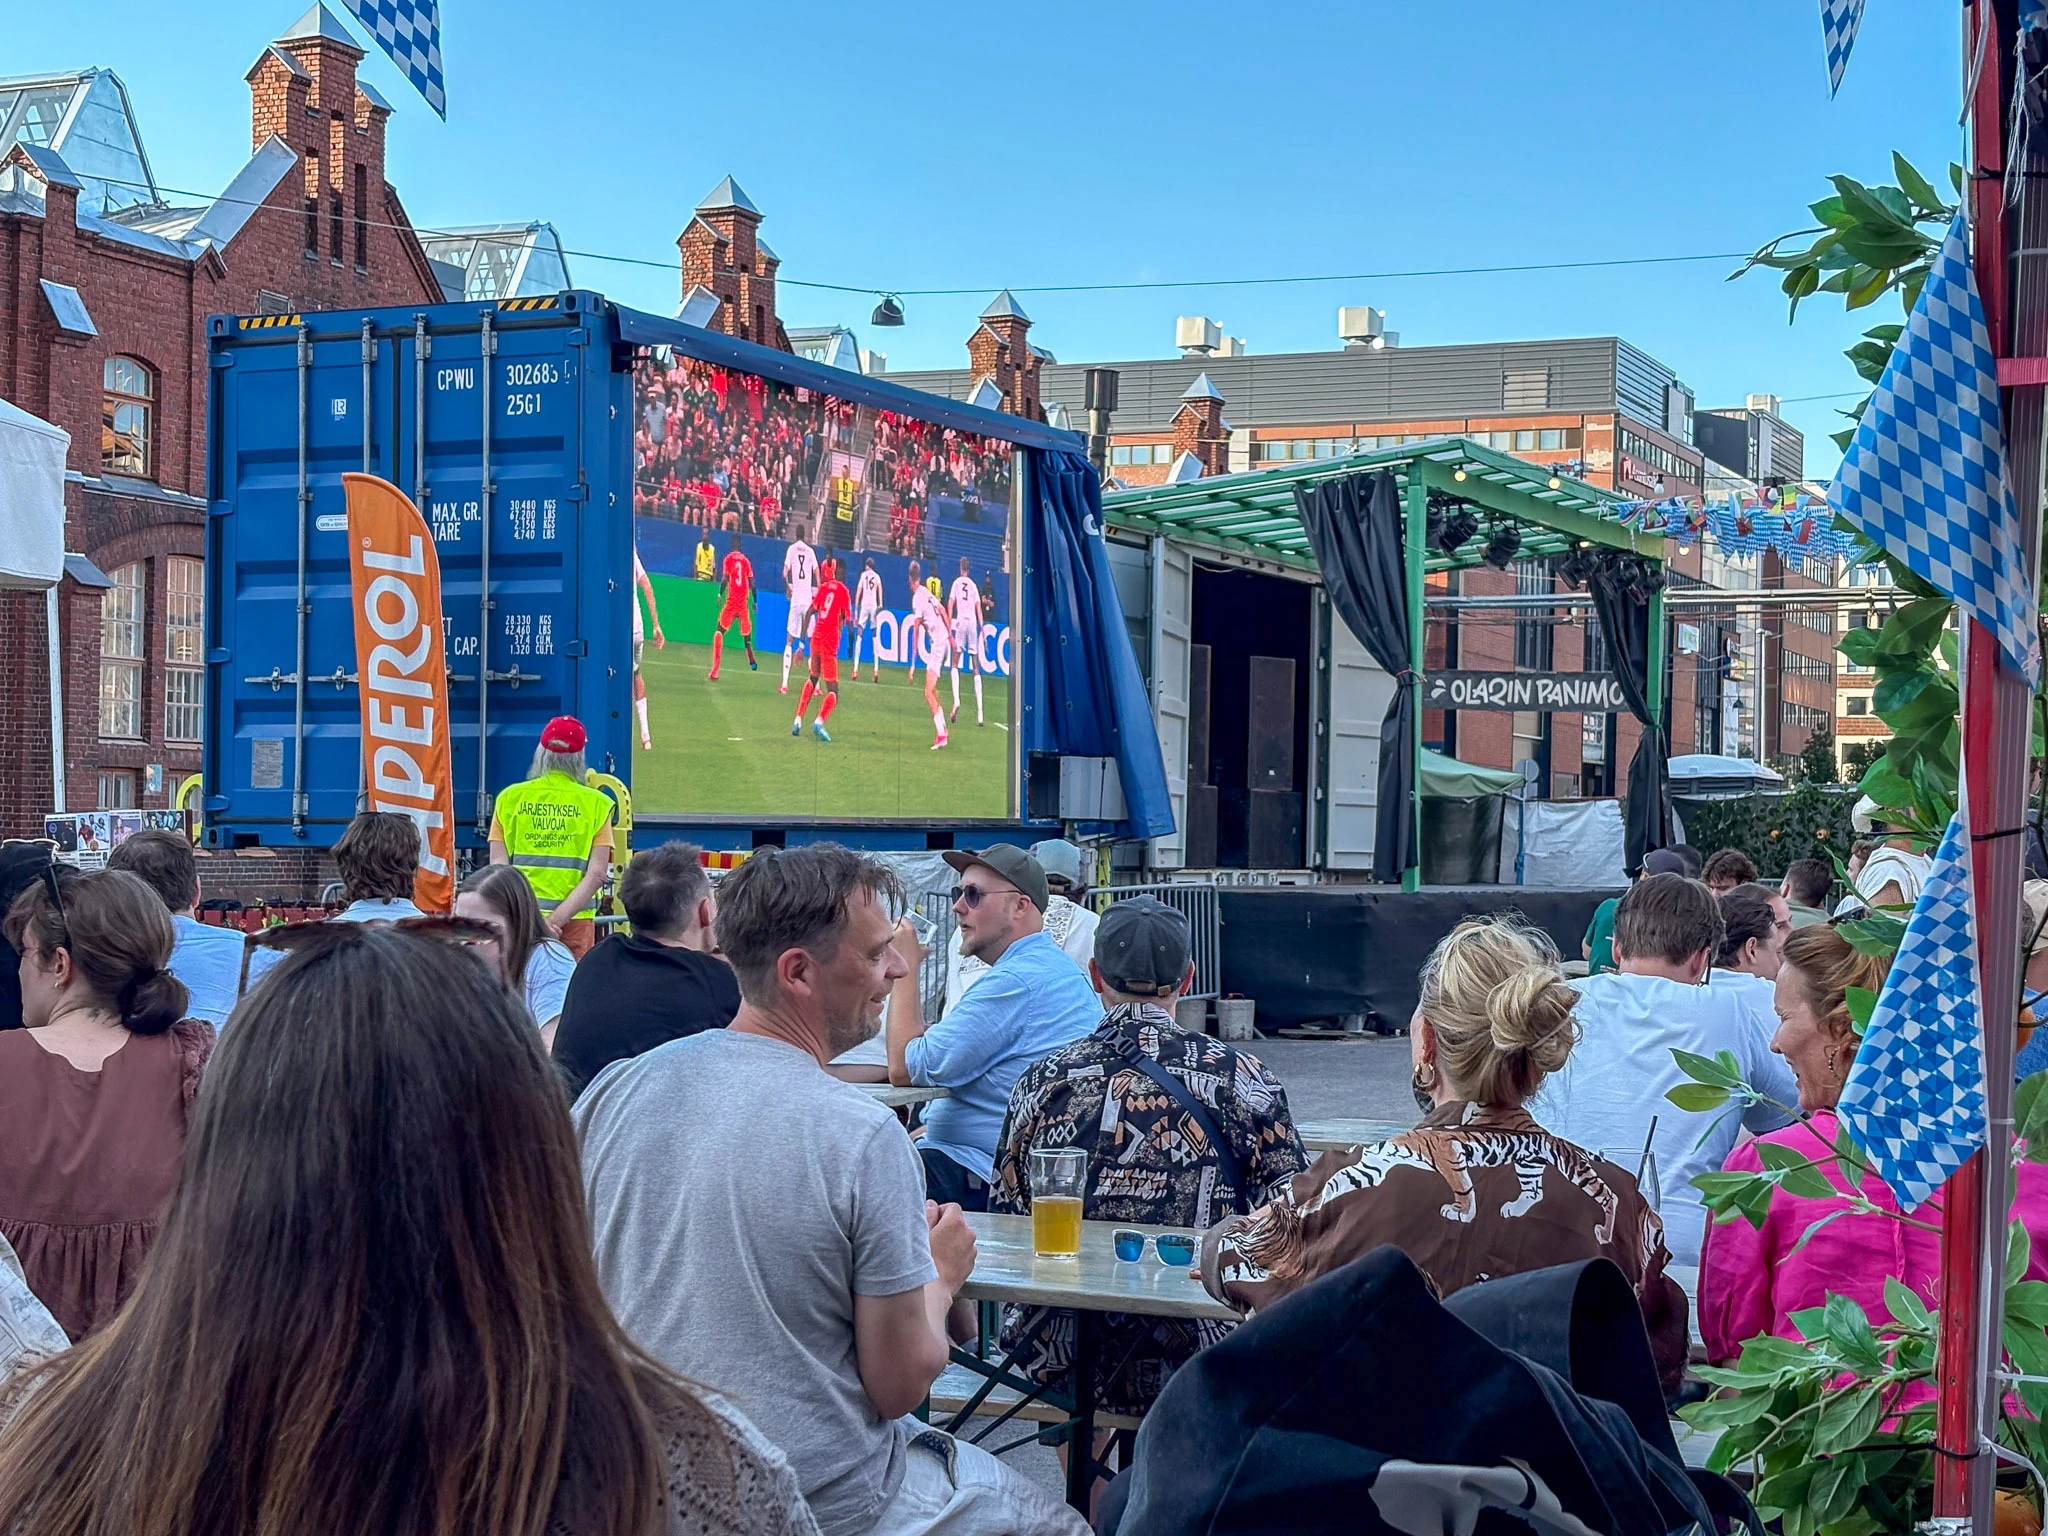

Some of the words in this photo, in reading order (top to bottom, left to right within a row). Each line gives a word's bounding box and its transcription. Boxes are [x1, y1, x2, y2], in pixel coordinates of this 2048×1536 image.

[438, 368, 474, 390] CPWU
[506, 394, 541, 415] 25G1
[510, 500, 536, 510] 30.480
[543, 499, 556, 510] KGS
[432, 502, 460, 521] MAX.
[463, 501, 481, 520] GR.
[509, 510, 536, 520] 67.200
[543, 509, 556, 520] LBS
[514, 520, 536, 530] 2.150
[543, 519, 556, 529] KGS
[432, 522, 461, 541] TARE
[514, 529, 535, 540] 4.740
[542, 529, 556, 539] LBS
[820, 592, 834, 619] 9
[505, 615, 531, 625] 28.330
[538, 615, 552, 625] KGS
[505, 625, 531, 635] 62.460
[538, 625, 552, 635] LBS
[454, 636, 480, 656] CAP.
[514, 635, 530, 645] 37.4
[510, 645, 530, 655] 1.320
[1450, 677, 1532, 706] OLARIN
[362, 535, 450, 876] APEROL
[532, 818, 566, 831] VALVOJA
[533, 840, 566, 848] SECURITY
